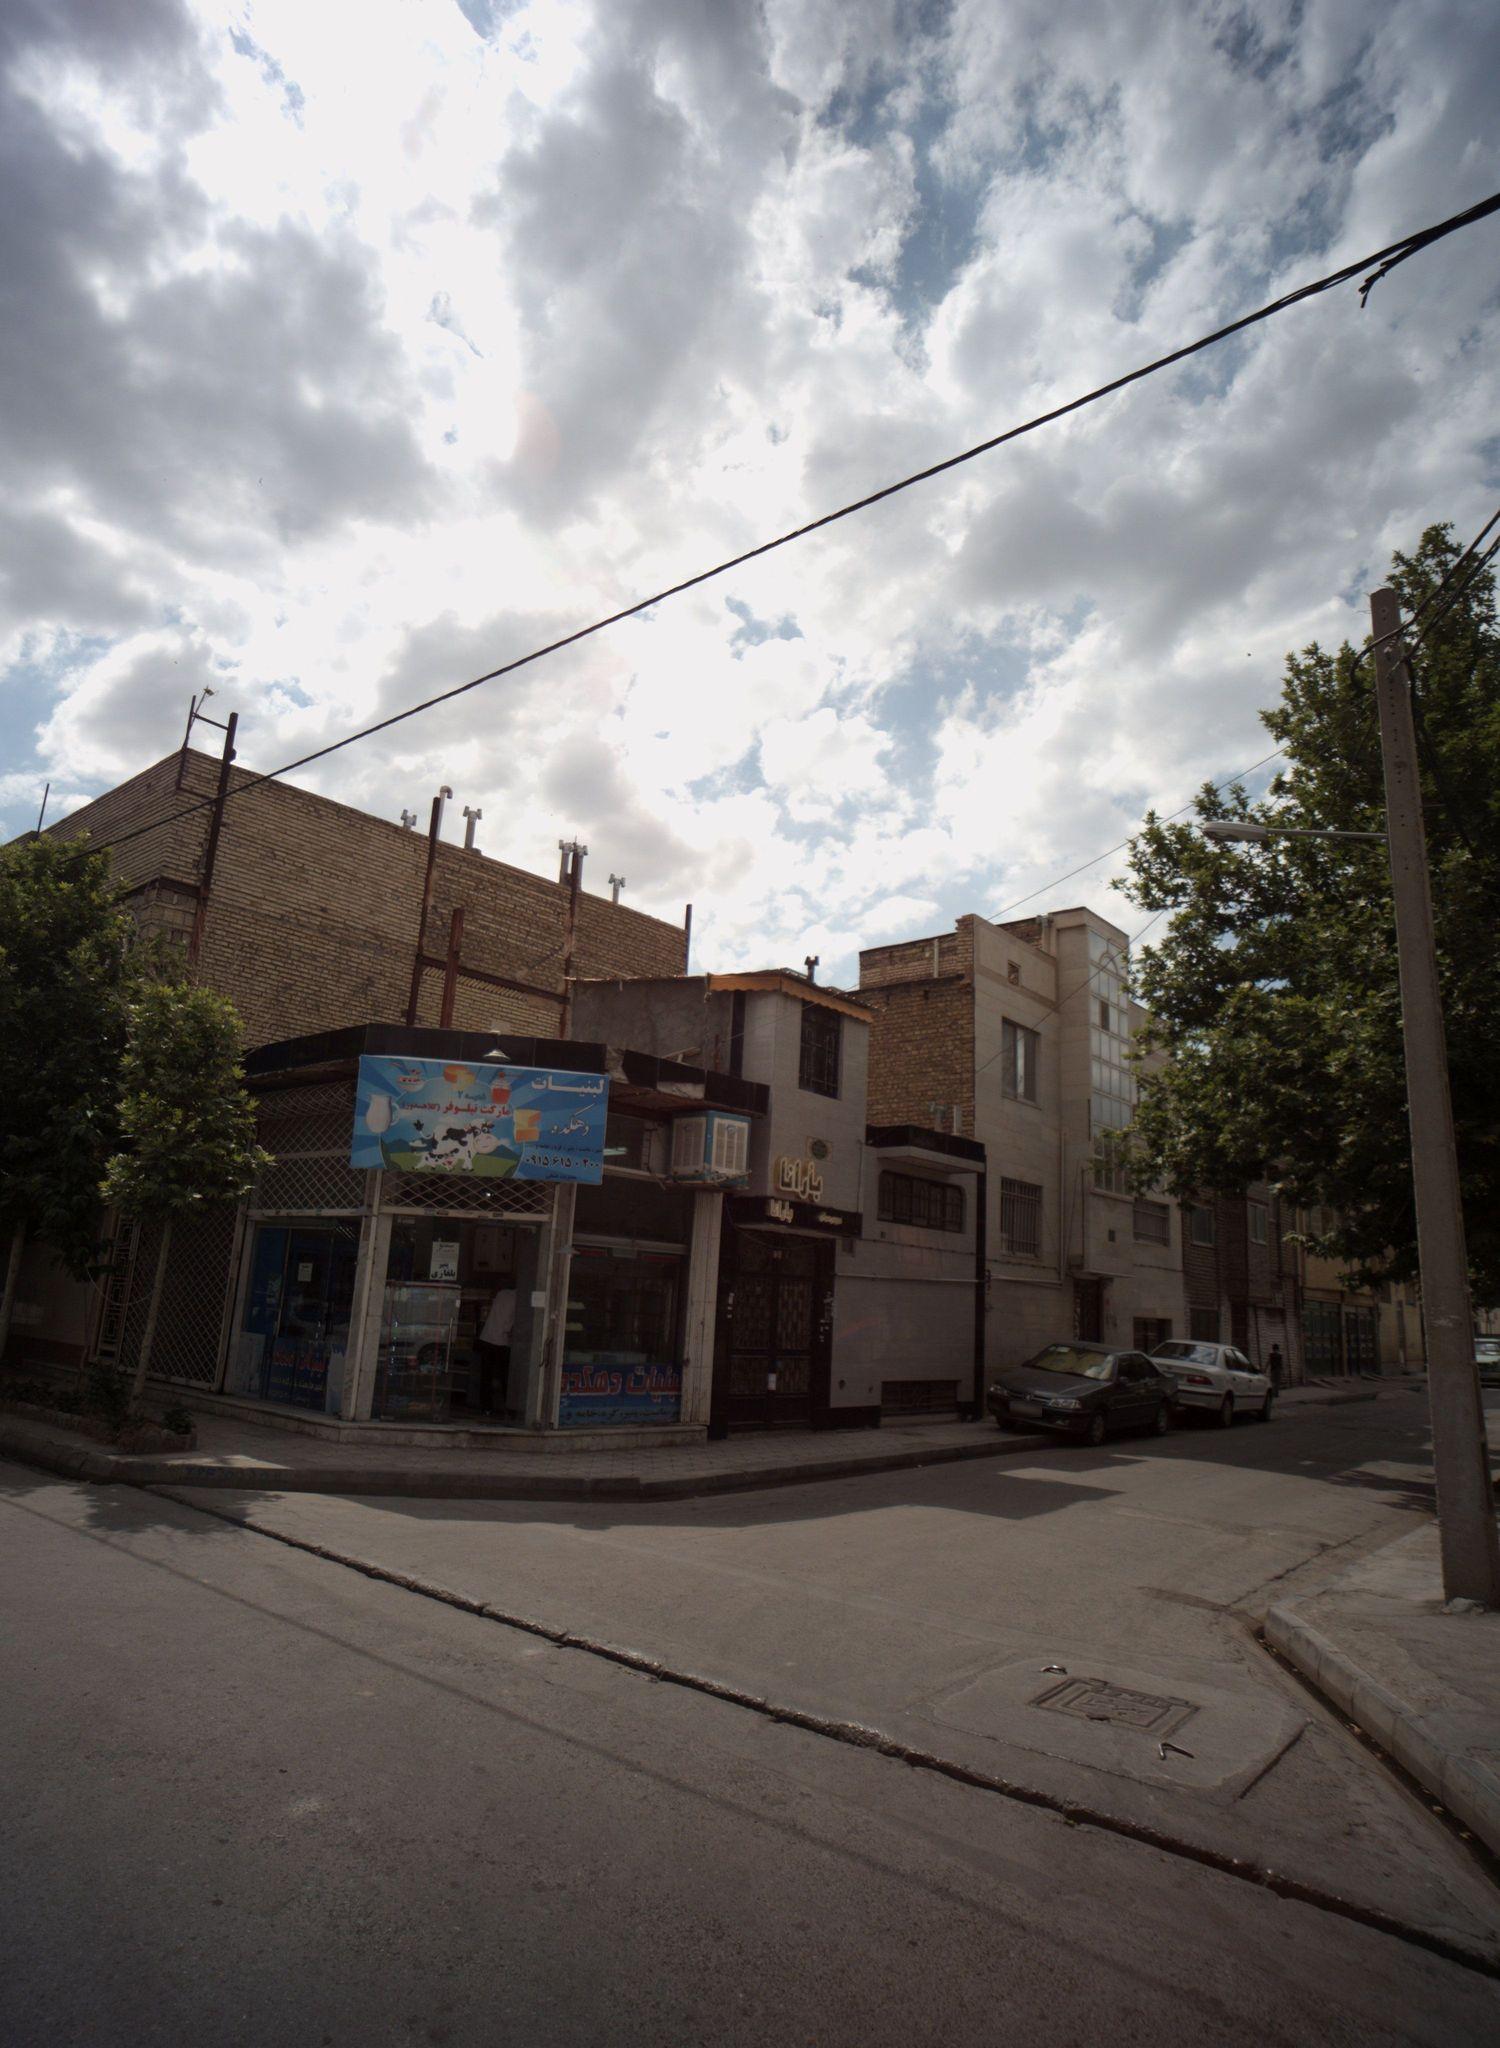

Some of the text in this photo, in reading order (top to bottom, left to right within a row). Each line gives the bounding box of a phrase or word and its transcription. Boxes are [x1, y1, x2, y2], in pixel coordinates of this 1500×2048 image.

[531, 1075, 604, 1098] لبنیات
[777, 1156, 824, 1202] بارانا
[626, 1366, 682, 1403] بنیات
